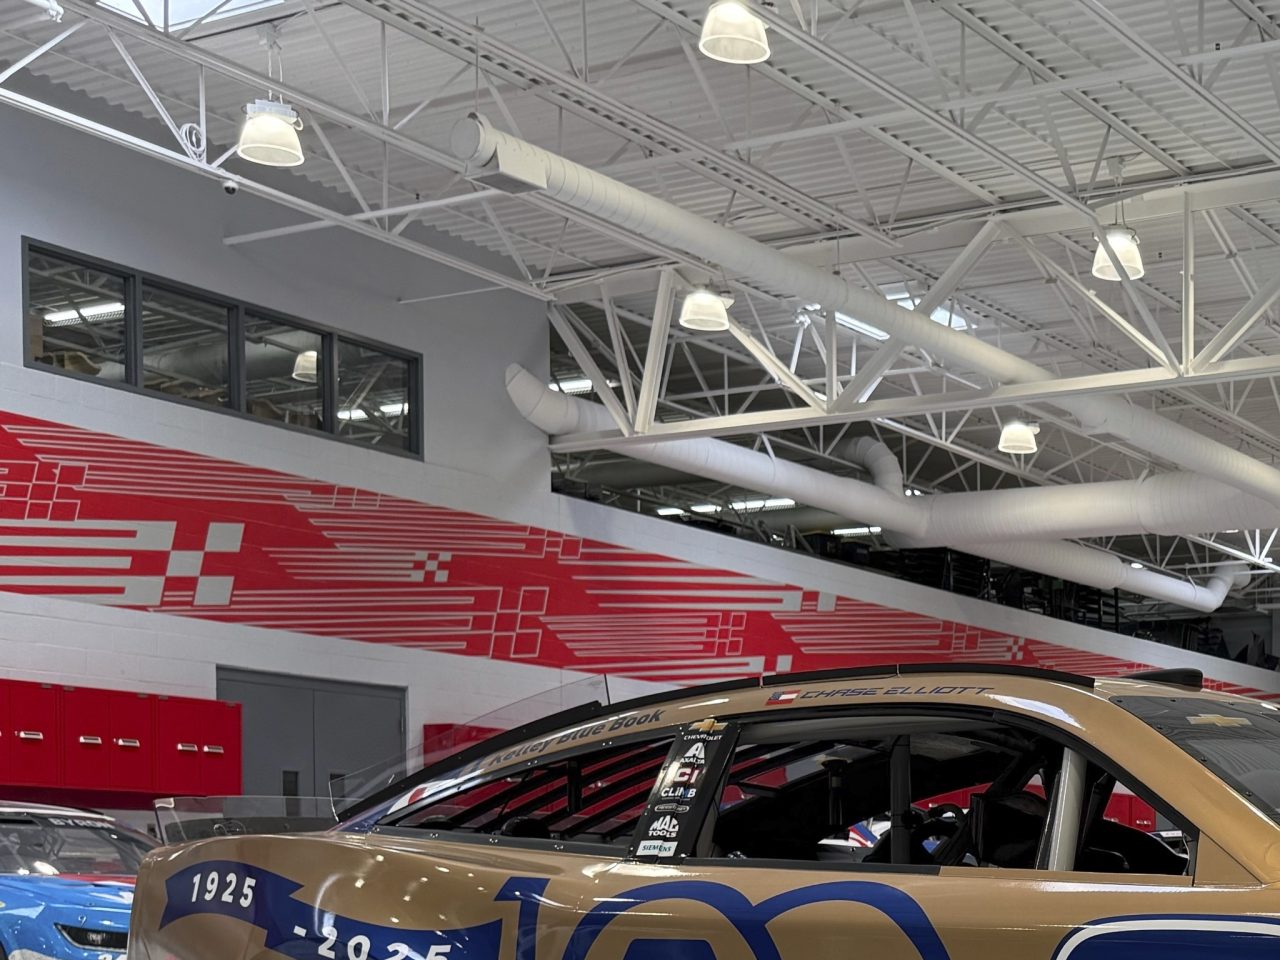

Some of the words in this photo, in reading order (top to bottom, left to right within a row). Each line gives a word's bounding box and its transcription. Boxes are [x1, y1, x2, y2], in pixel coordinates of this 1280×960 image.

[800, 687, 884, 699] CHASE
[883, 686, 996, 696] ELLIOTT
[556, 724, 605, 745] Blue
[608, 709, 667, 732] Book
[649, 815, 679, 832] MAC
[648, 830, 677, 838] TOOLS
[642, 844, 672, 852] SIEMENS
[191, 871, 256, 908] 1925
